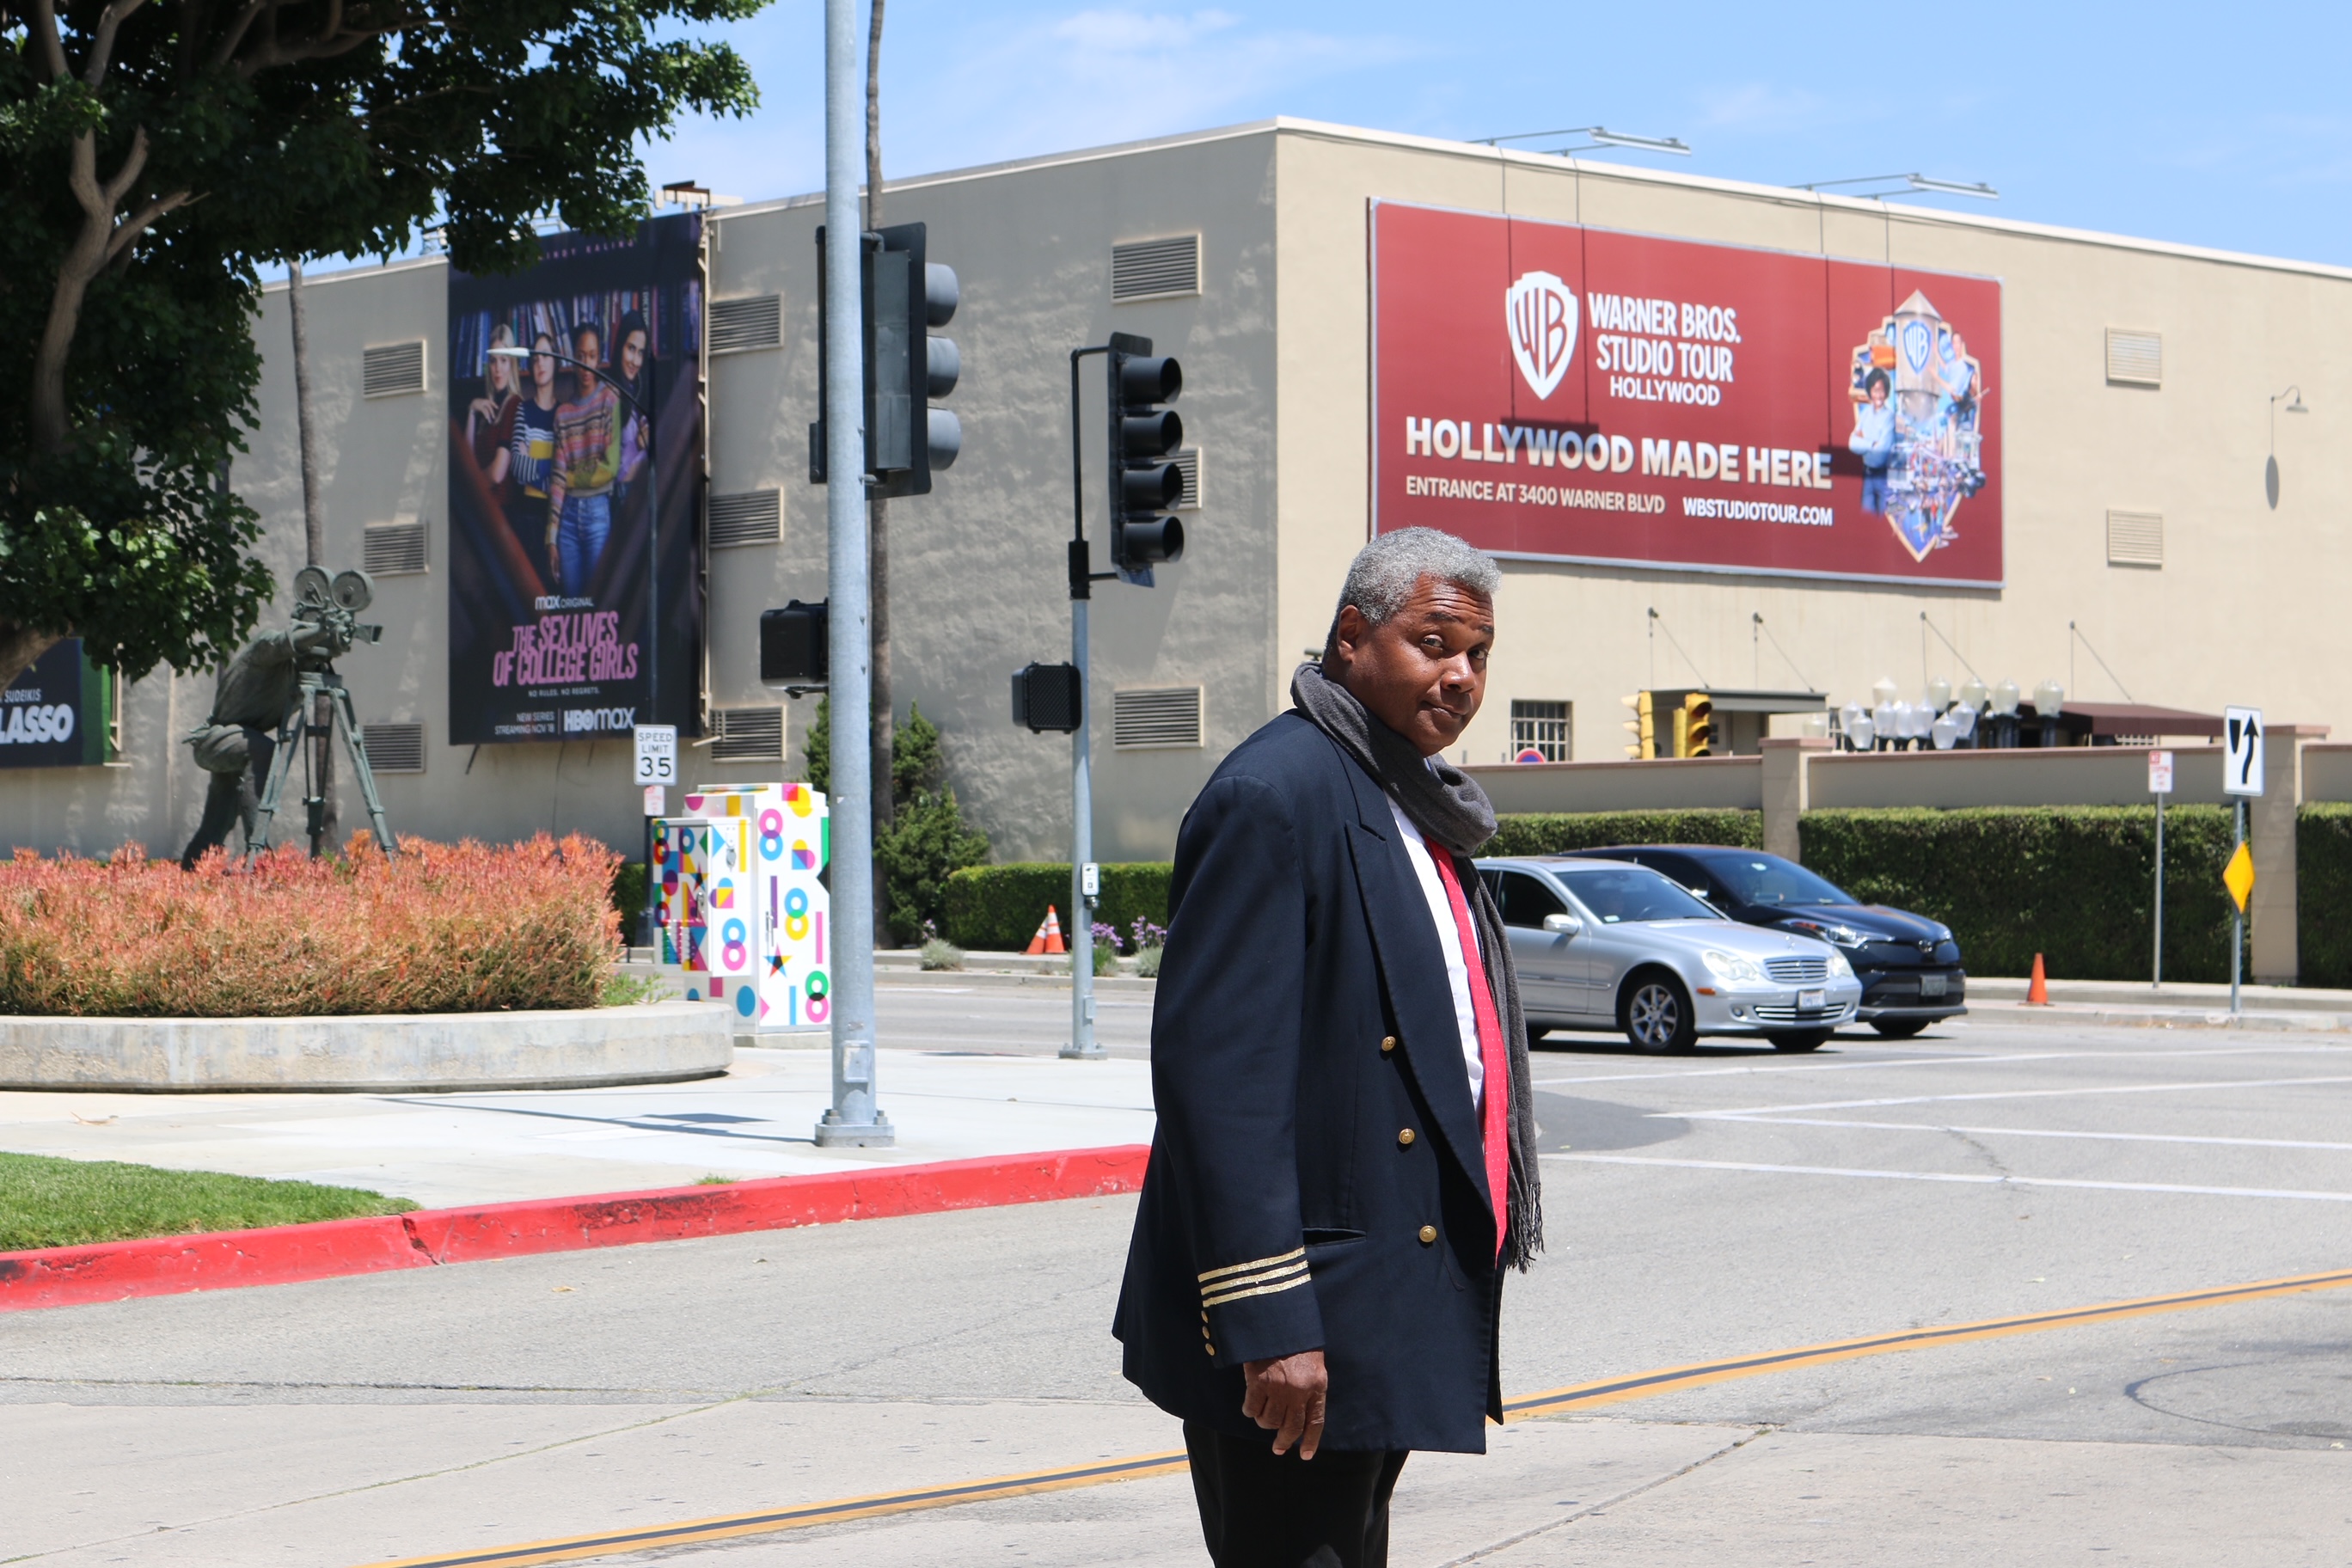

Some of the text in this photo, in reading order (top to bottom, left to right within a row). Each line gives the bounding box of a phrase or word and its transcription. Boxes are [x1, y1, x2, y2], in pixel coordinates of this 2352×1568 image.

[537, 248, 576, 260] INDY
[1587, 291, 1742, 344] WARNER BROS.
[1596, 333, 1734, 383] STUDIO TOUR
[1609, 375, 1721, 407] HOLLYWOOD
[1406, 415, 1833, 489] HOLLYWOOD MADE HERE
[1406, 475, 1666, 514] ENTRANCE AT 3400 WARNER BLVD
[1681, 496, 1834, 526] WBSTUDIOTOUR.COM
[560, 597, 594, 609] ORIGINAL
[511, 610, 619, 653] THE SEX LIVES
[493, 642, 639, 687] OF COLLEGE GIRLS
[4, 689, 42, 703] SUDEIKIS
[494, 724, 531, 735] STREAMING
[516, 711, 555, 723] NEW SERIES
[638, 732, 672, 743] SPEED
[641, 744, 669, 754] LIMIT
[640, 756, 671, 777] 35
